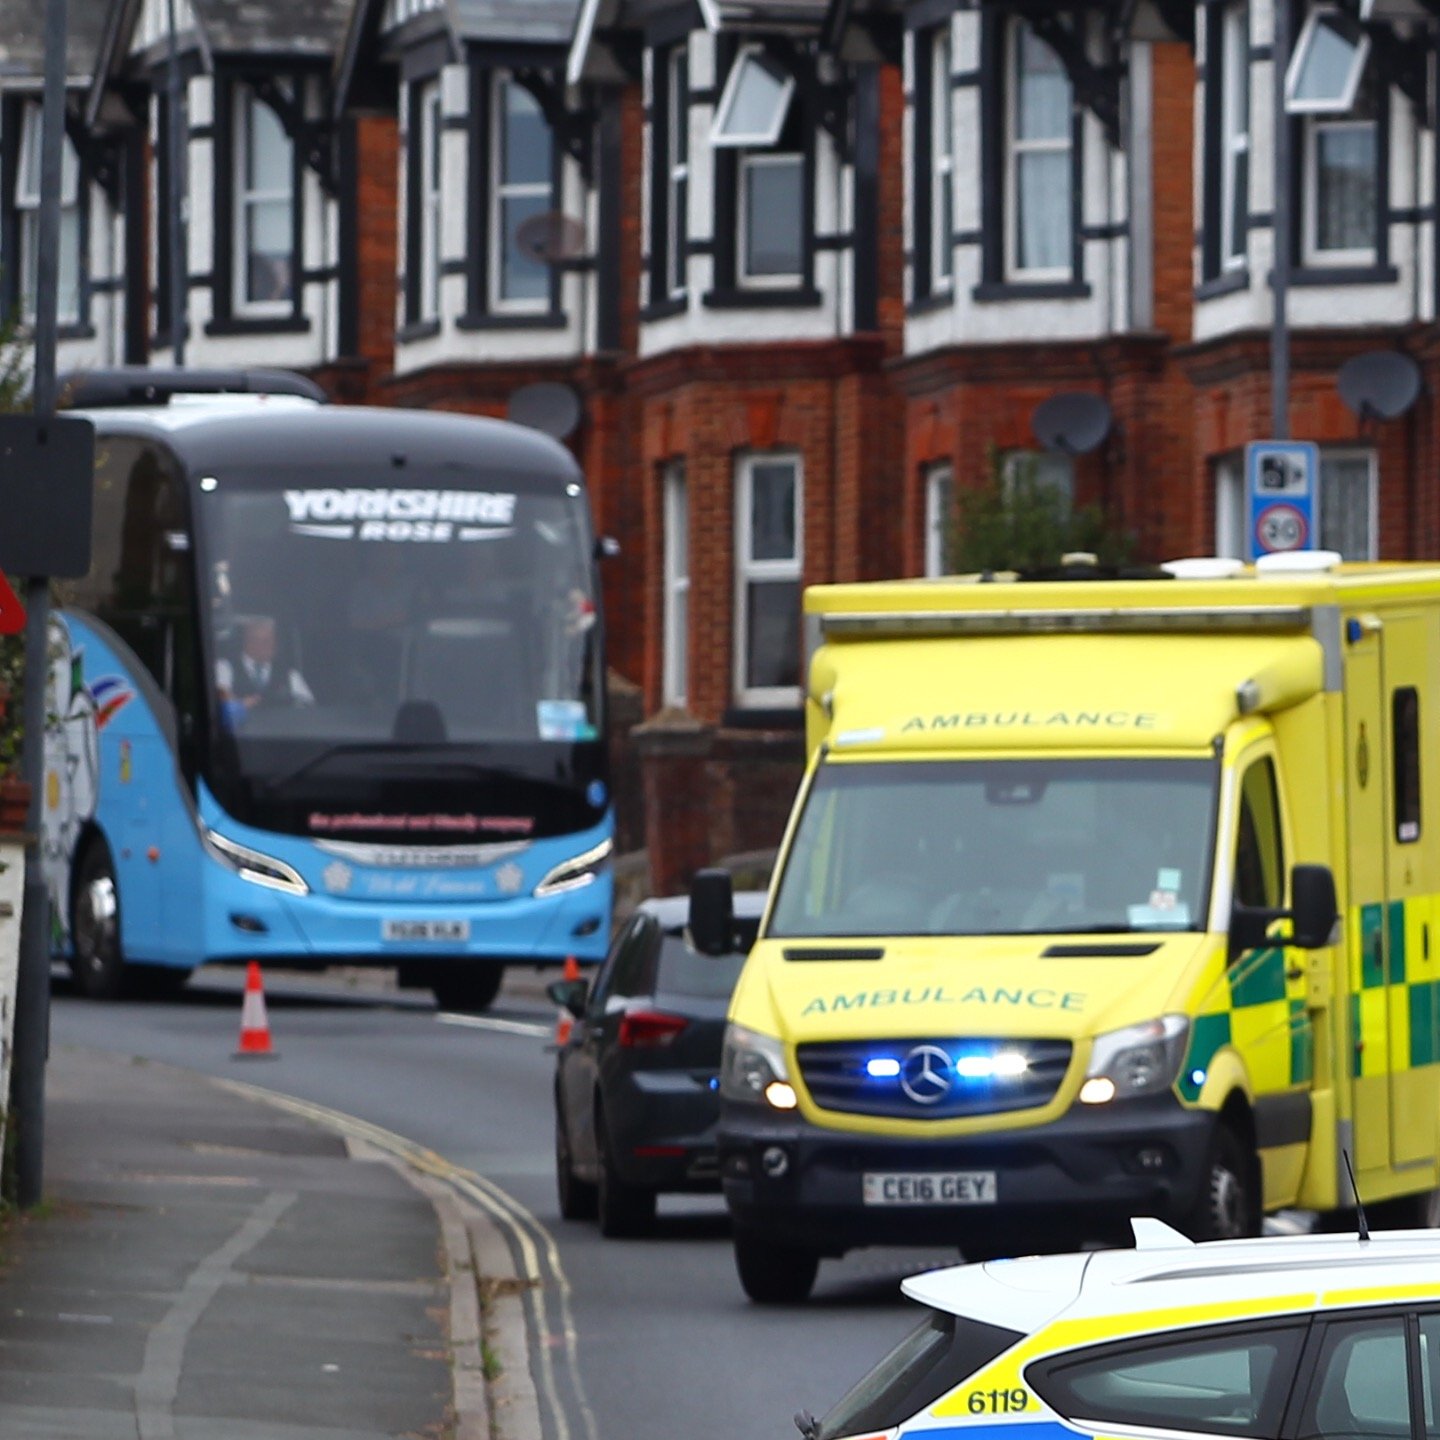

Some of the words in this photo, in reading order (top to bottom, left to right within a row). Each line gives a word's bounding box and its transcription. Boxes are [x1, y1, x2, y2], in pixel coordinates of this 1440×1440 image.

[284, 489, 518, 524] YORKSHIRE
[358, 520, 453, 543] ROSE
[1267, 519, 1298, 540] 30
[901, 711, 1159, 734] AMBULANCE
[800, 986, 1088, 1018] AMBULANCE
[883, 1176, 934, 1200] CE16
[940, 1175, 986, 1200] GEY
[968, 1388, 1028, 1415] 6119
